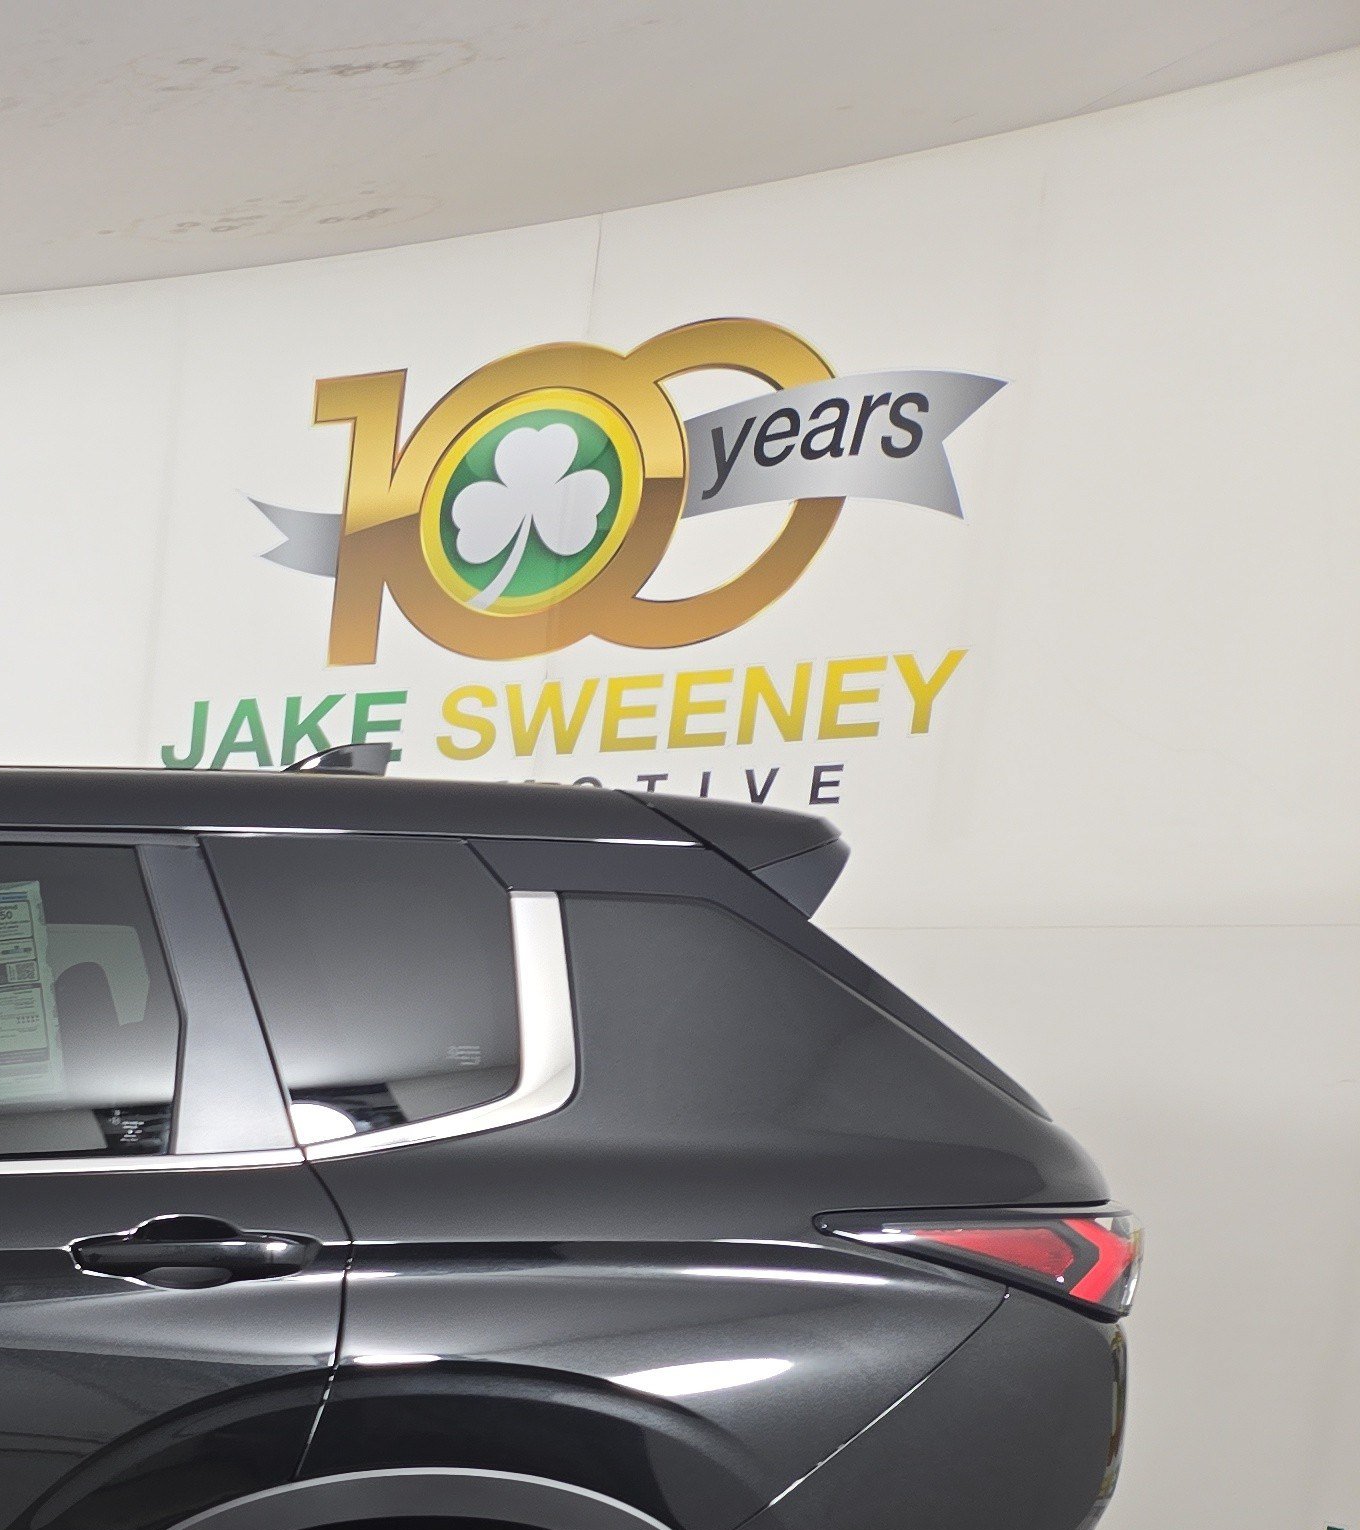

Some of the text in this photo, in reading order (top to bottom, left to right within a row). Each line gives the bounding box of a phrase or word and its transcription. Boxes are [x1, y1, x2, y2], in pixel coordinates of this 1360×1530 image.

[702, 392, 930, 501] years
[161, 648, 970, 770] JAKE SWEENEY
